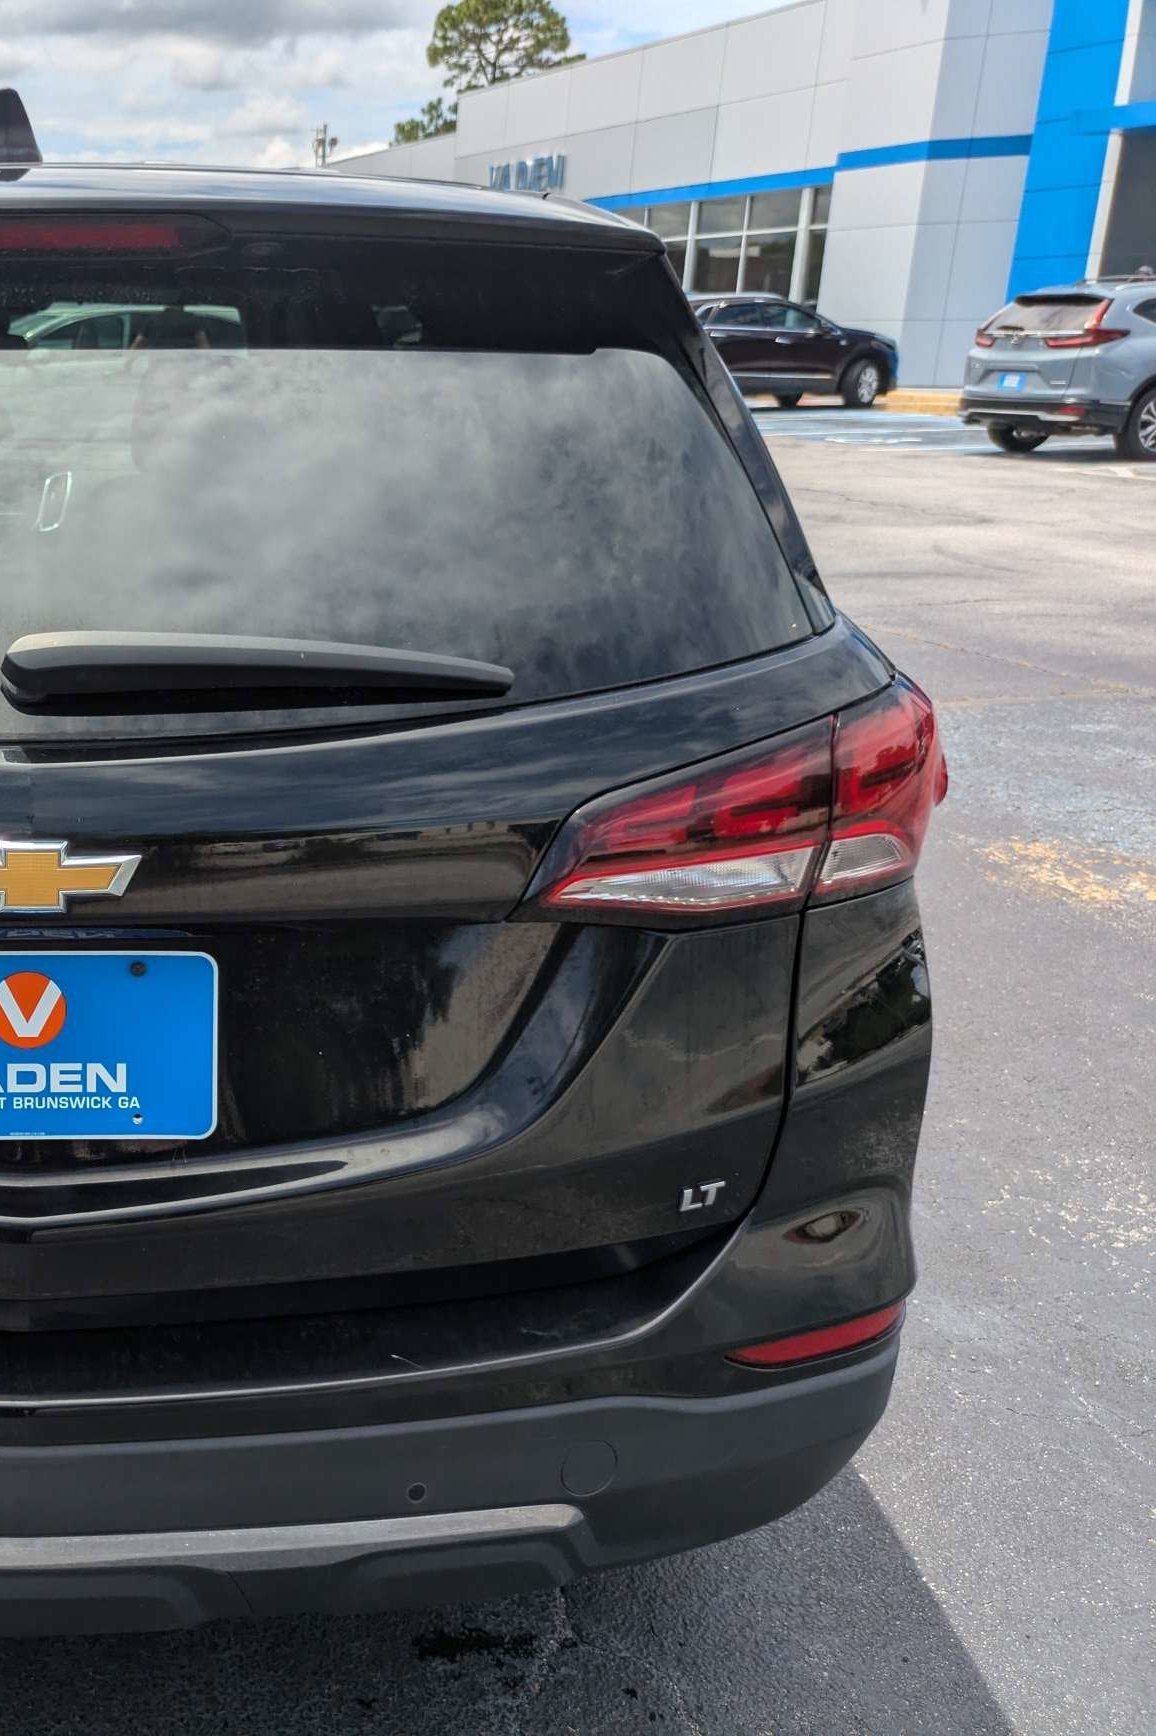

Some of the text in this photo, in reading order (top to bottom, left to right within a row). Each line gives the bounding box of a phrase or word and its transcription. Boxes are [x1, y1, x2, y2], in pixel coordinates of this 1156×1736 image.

[12, 1096, 112, 1110] BRUNSWICK
[118, 1096, 141, 1110] GA
[679, 1180, 726, 1212] LT
